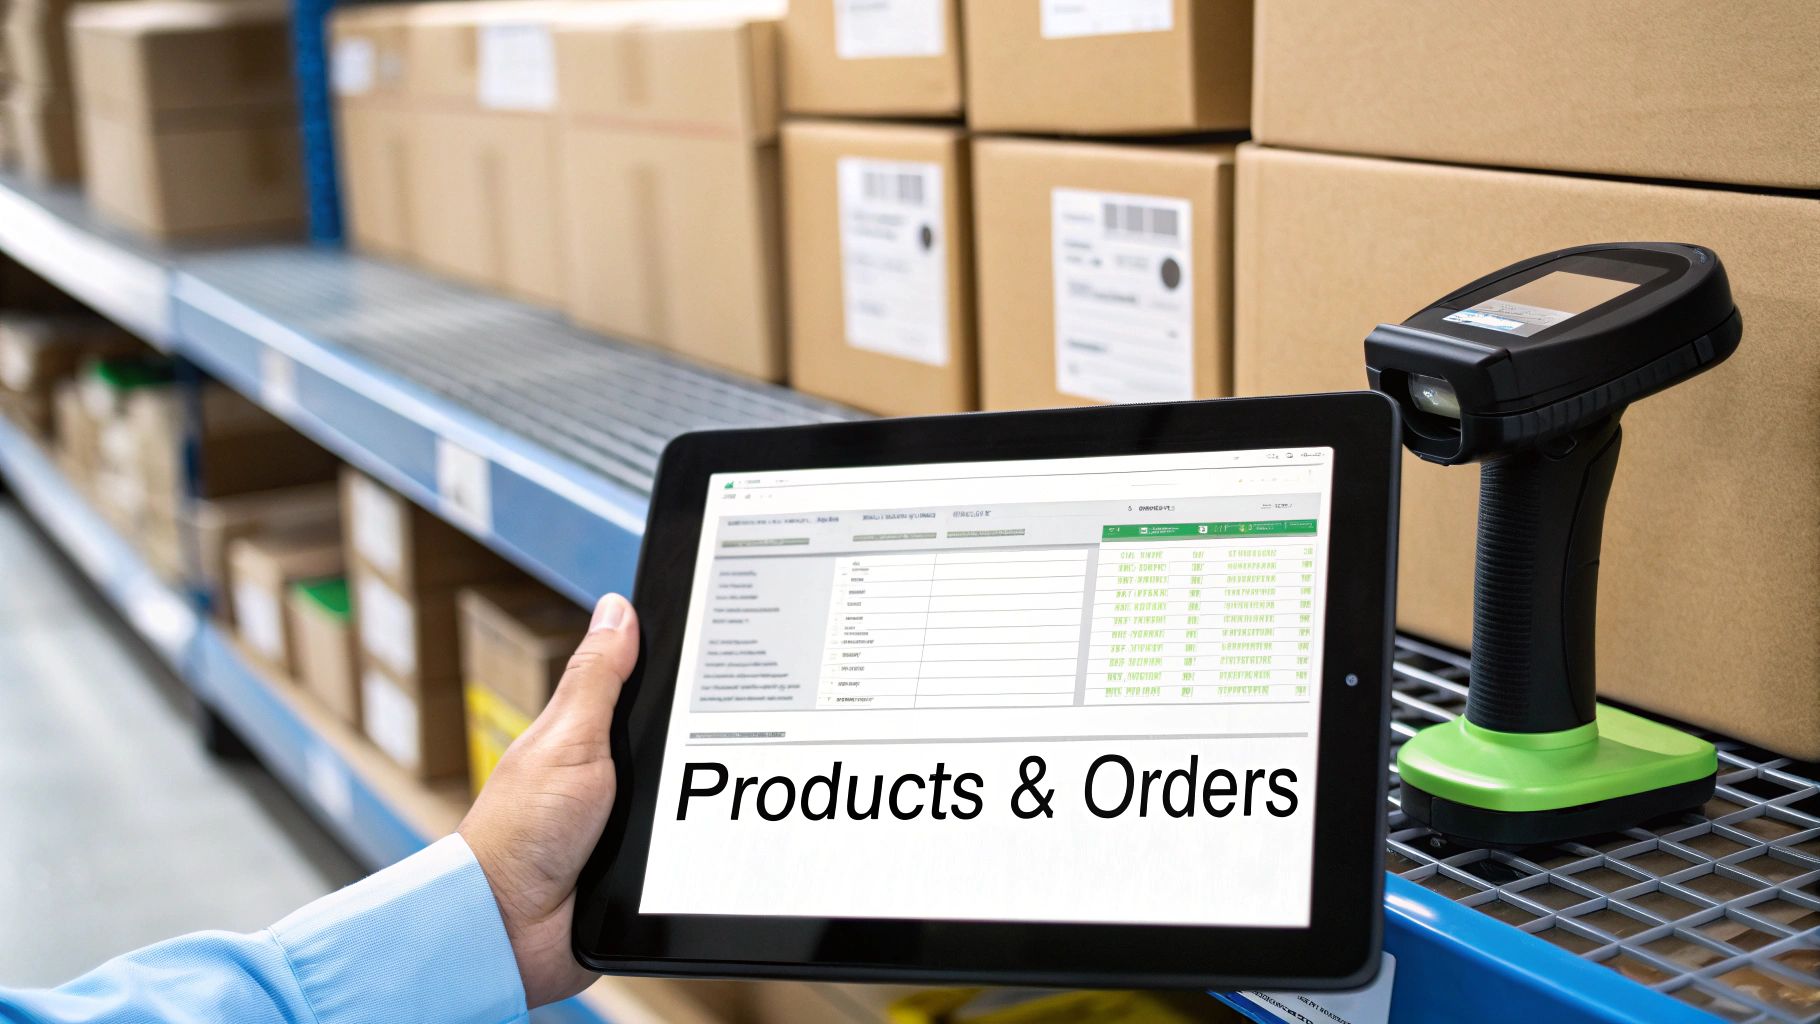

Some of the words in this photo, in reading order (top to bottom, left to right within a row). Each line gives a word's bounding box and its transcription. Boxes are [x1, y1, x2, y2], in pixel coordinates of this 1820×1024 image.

[677, 762, 984, 821] Products
[1011, 755, 1055, 819] &
[1085, 754, 1299, 818] Orders
